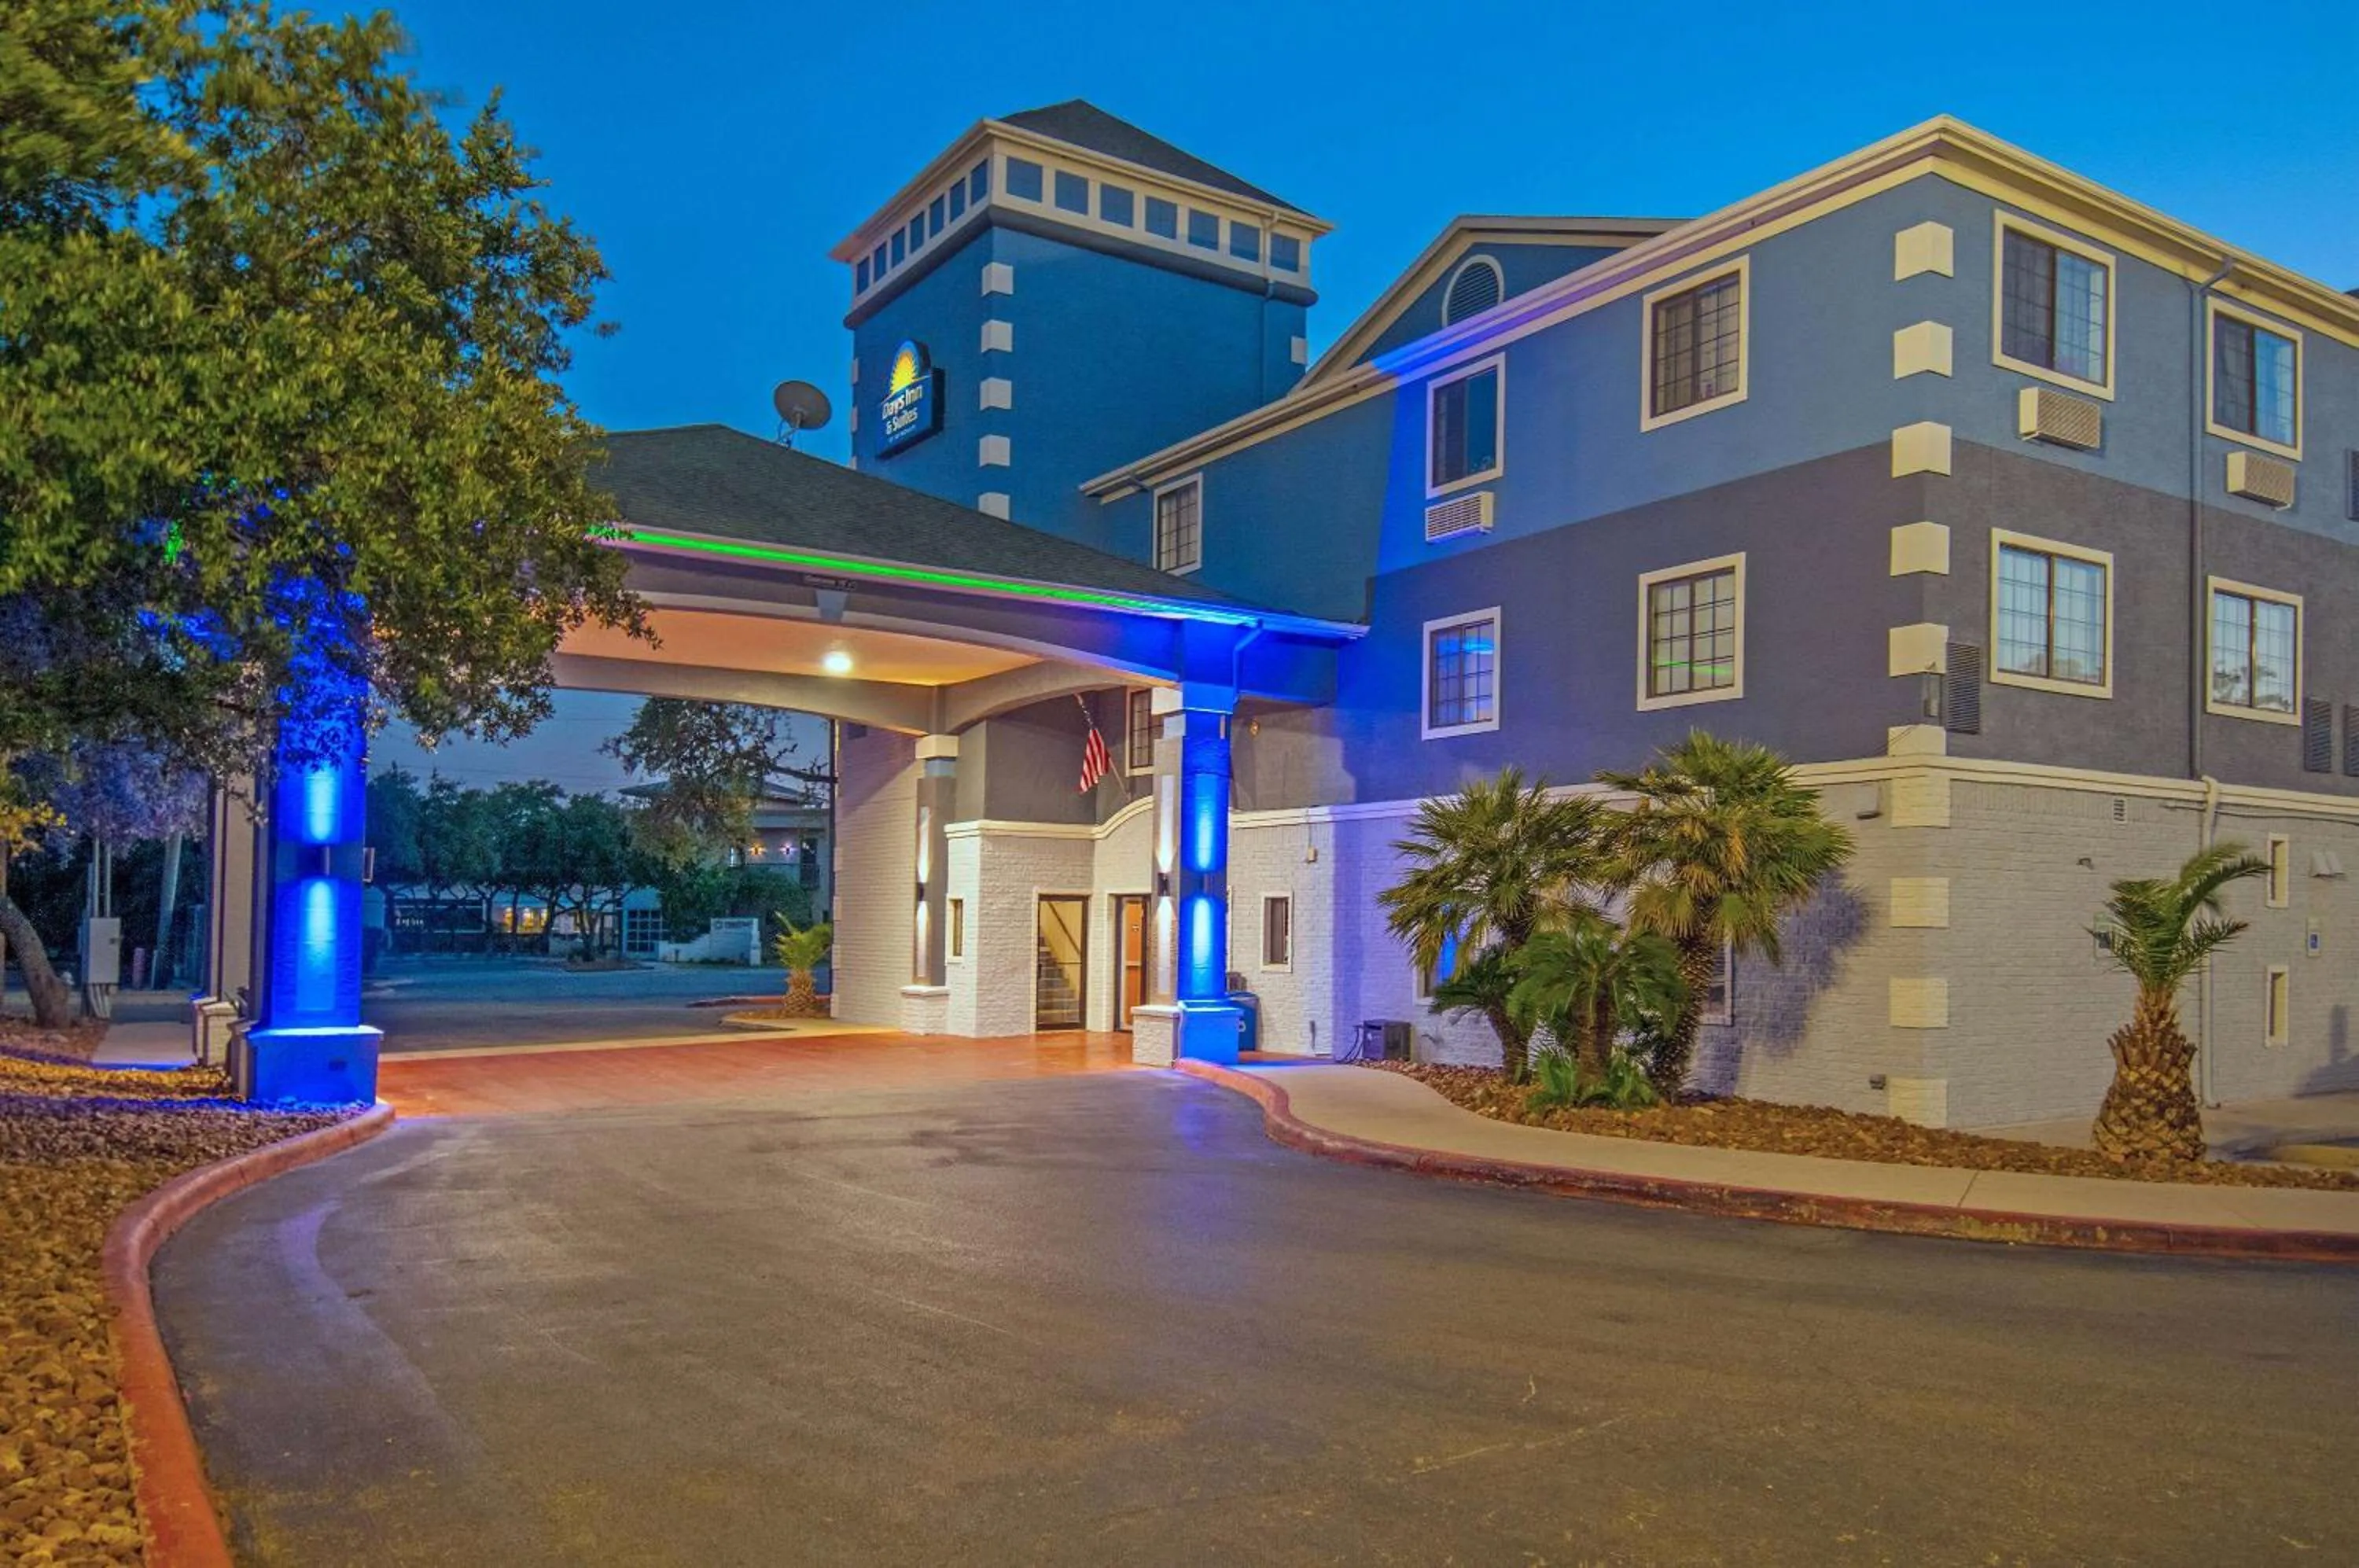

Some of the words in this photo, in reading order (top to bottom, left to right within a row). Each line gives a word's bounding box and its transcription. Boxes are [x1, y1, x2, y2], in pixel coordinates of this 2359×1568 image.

[881, 394, 905, 420] Days
[905, 385, 922, 406] Inn
[885, 421, 892, 435] &
[892, 407, 918, 432] Suites
